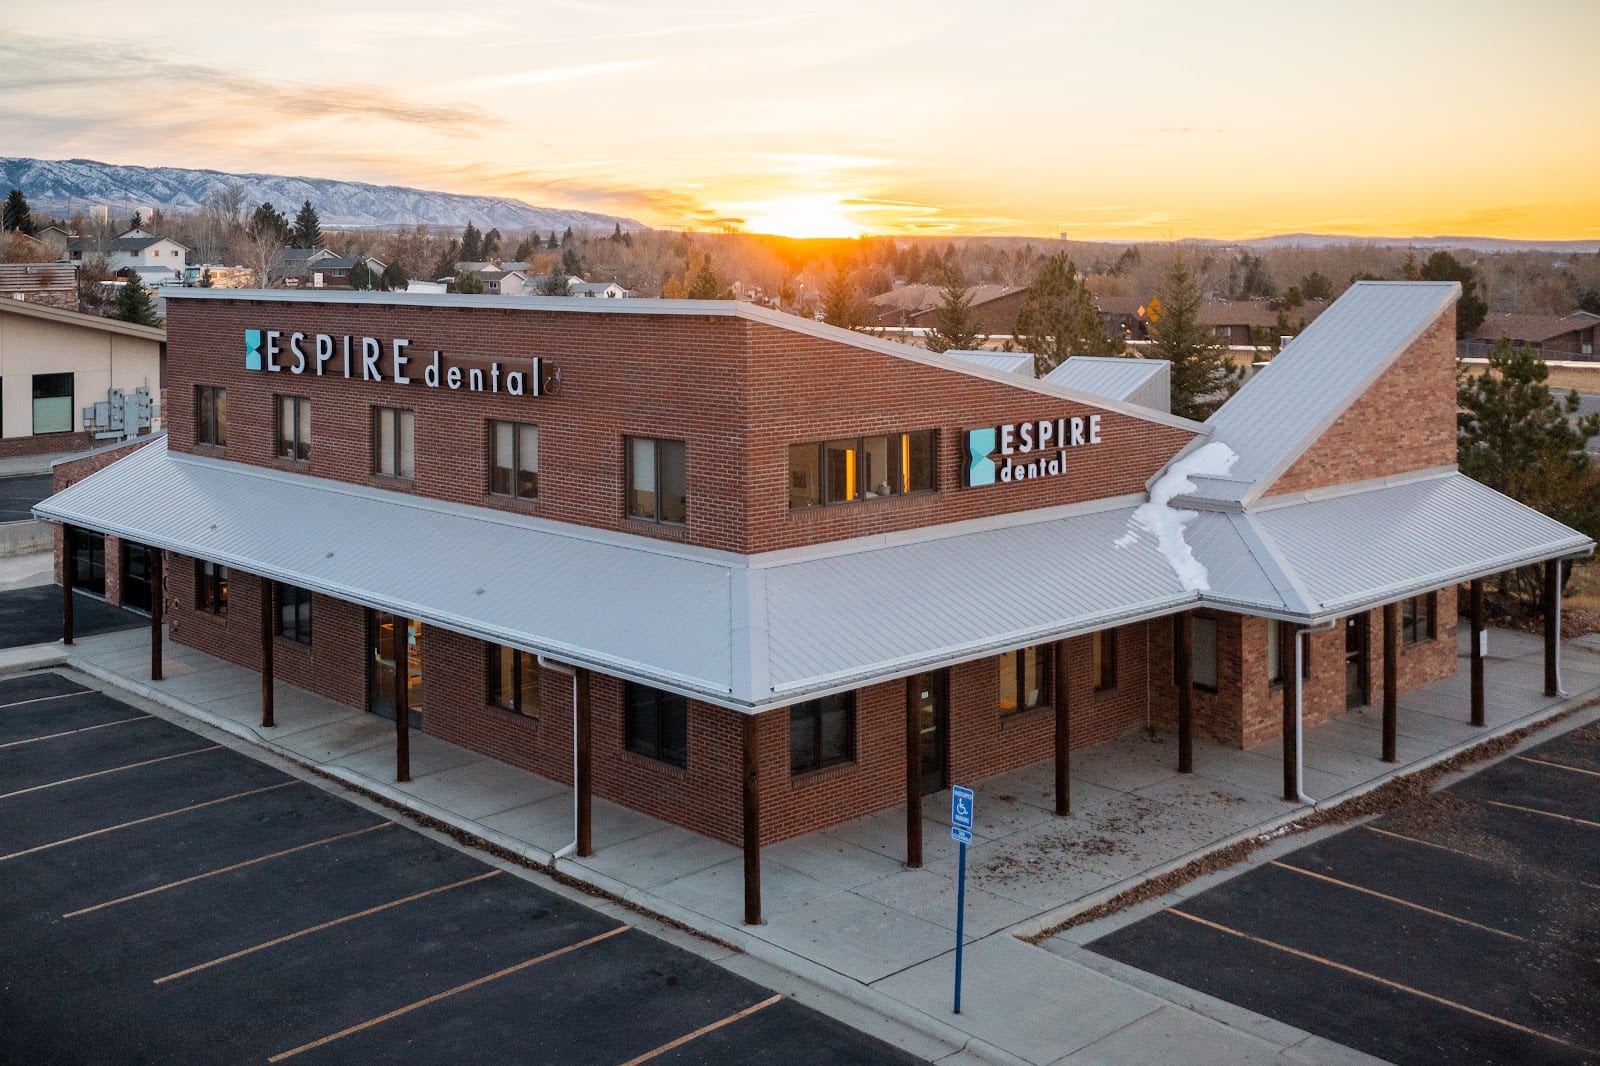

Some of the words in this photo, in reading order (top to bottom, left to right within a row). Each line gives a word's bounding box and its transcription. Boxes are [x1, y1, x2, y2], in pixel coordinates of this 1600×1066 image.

[267, 331, 411, 384] ESPIRE
[424, 350, 539, 397] dental
[1001, 414, 1102, 455] ESPIRE
[1000, 450, 1067, 482] dental
